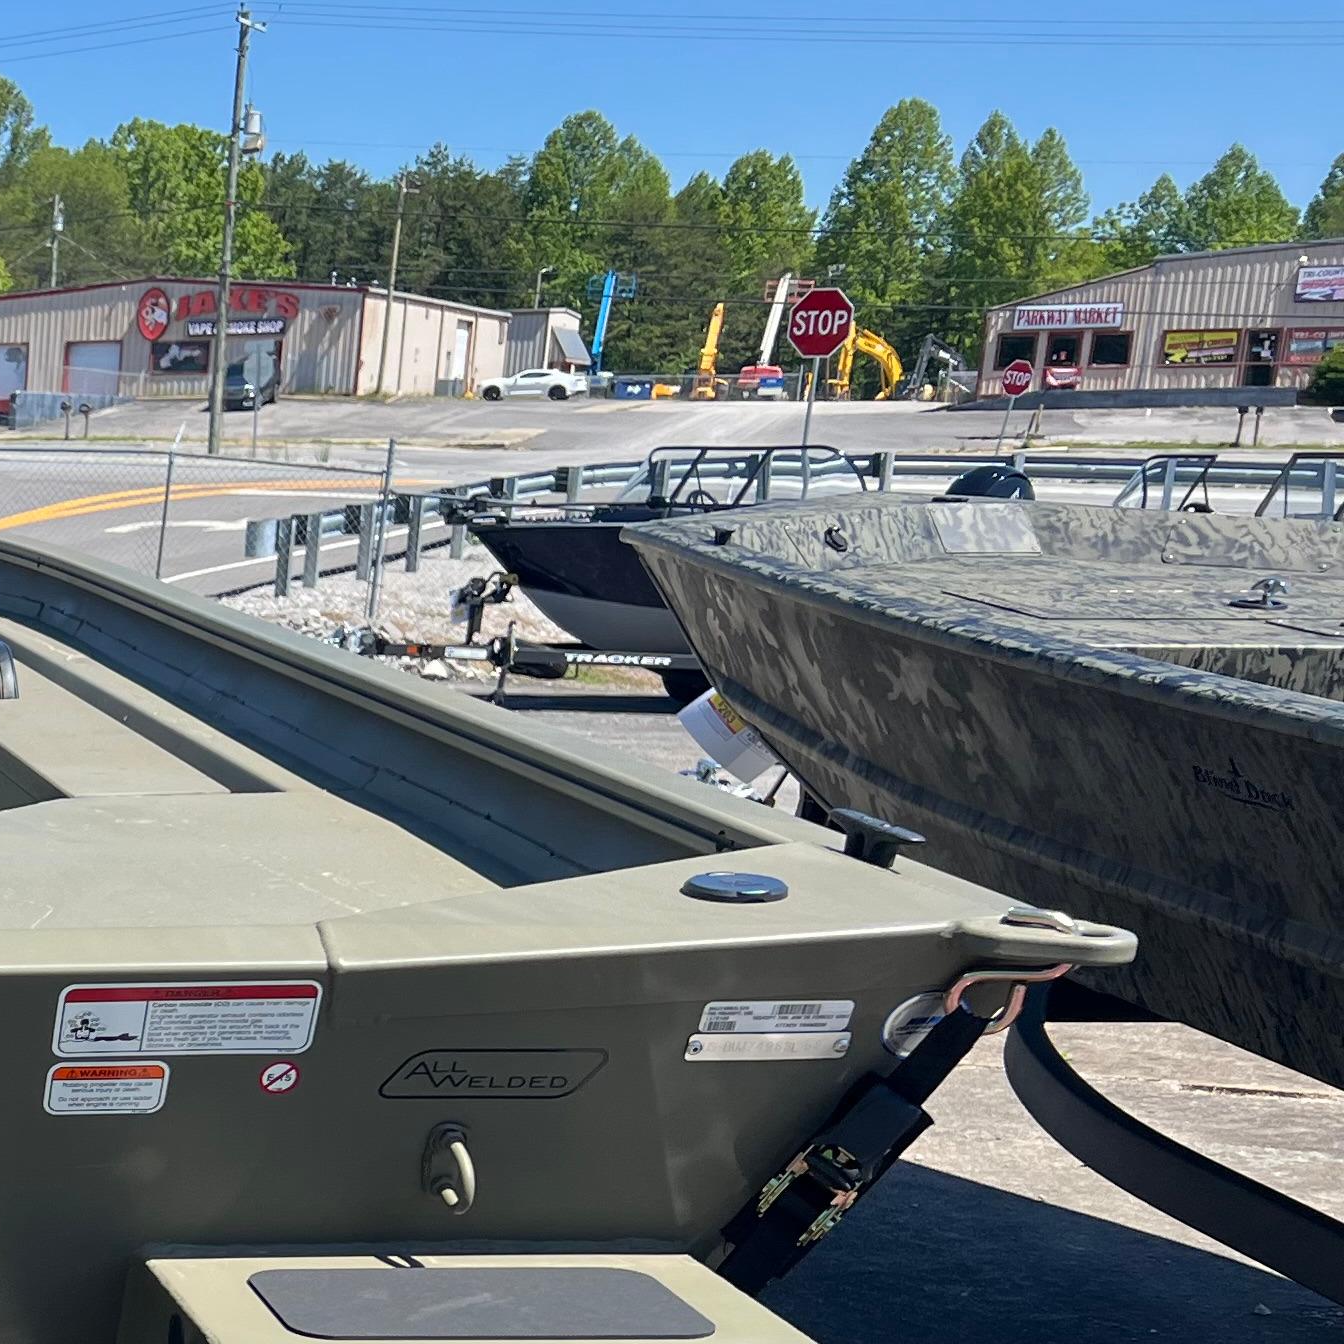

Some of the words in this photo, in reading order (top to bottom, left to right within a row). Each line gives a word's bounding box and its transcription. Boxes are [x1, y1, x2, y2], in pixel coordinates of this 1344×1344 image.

[1303, 269, 1344, 278] TRI-COUNT
[175, 288, 300, 321] JAKE'S
[792, 309, 849, 337] STOP
[1017, 309, 1068, 326] PARKWAY
[1073, 306, 1119, 324] MARKET
[257, 320, 284, 333] SHOP
[1004, 371, 1031, 388] STOP
[564, 653, 672, 666] TRACKER
[80, 1070, 138, 1078] WARNING
[429, 1074, 568, 1089] WELDED
